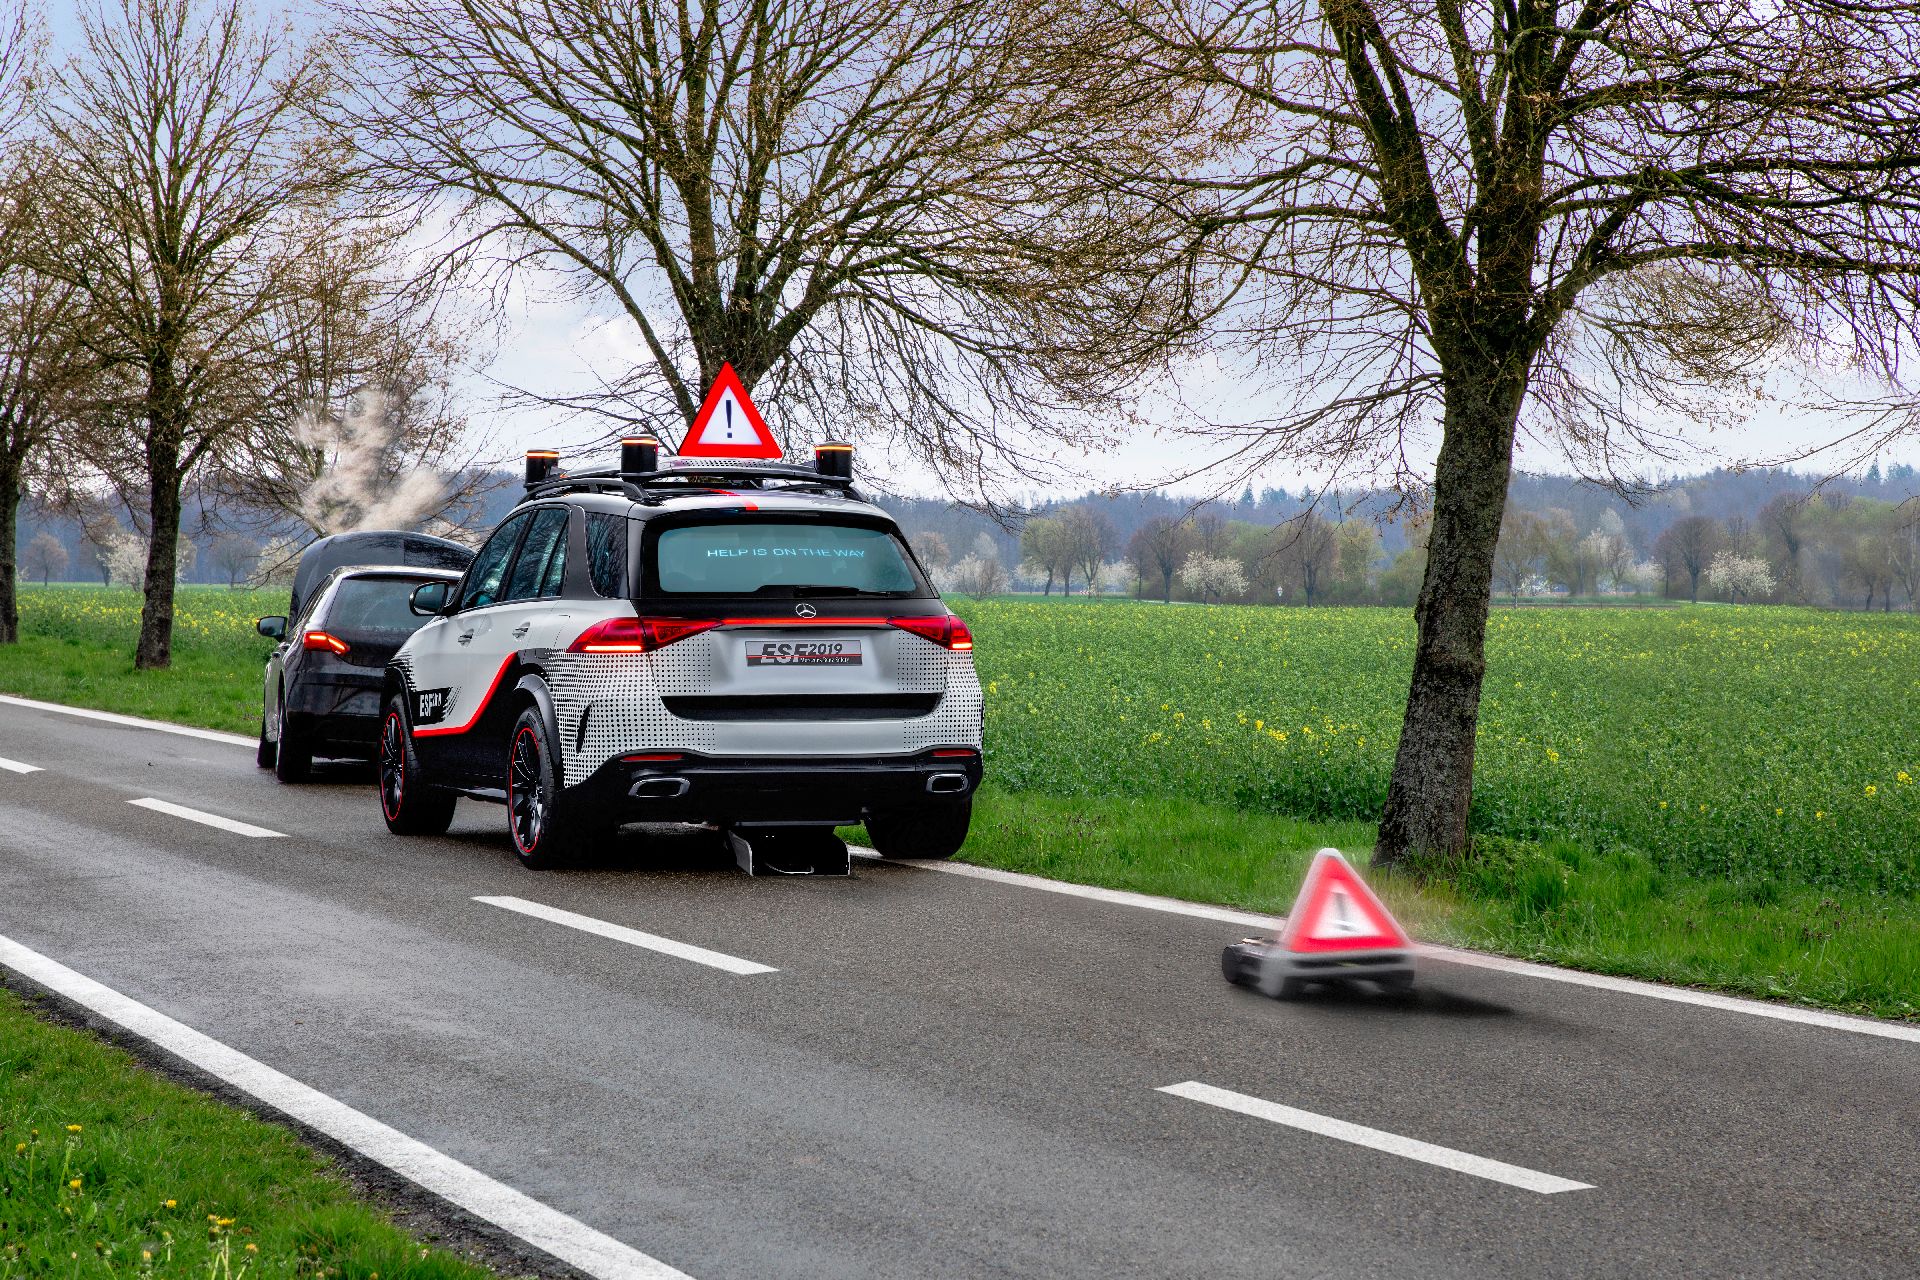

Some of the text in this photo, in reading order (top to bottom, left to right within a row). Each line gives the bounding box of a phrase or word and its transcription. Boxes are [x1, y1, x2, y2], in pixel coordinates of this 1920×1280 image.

[707, 548, 865, 558] HELP IS ON THE WAY
[761, 643, 808, 663] ESF
[808, 643, 842, 655] 2019
